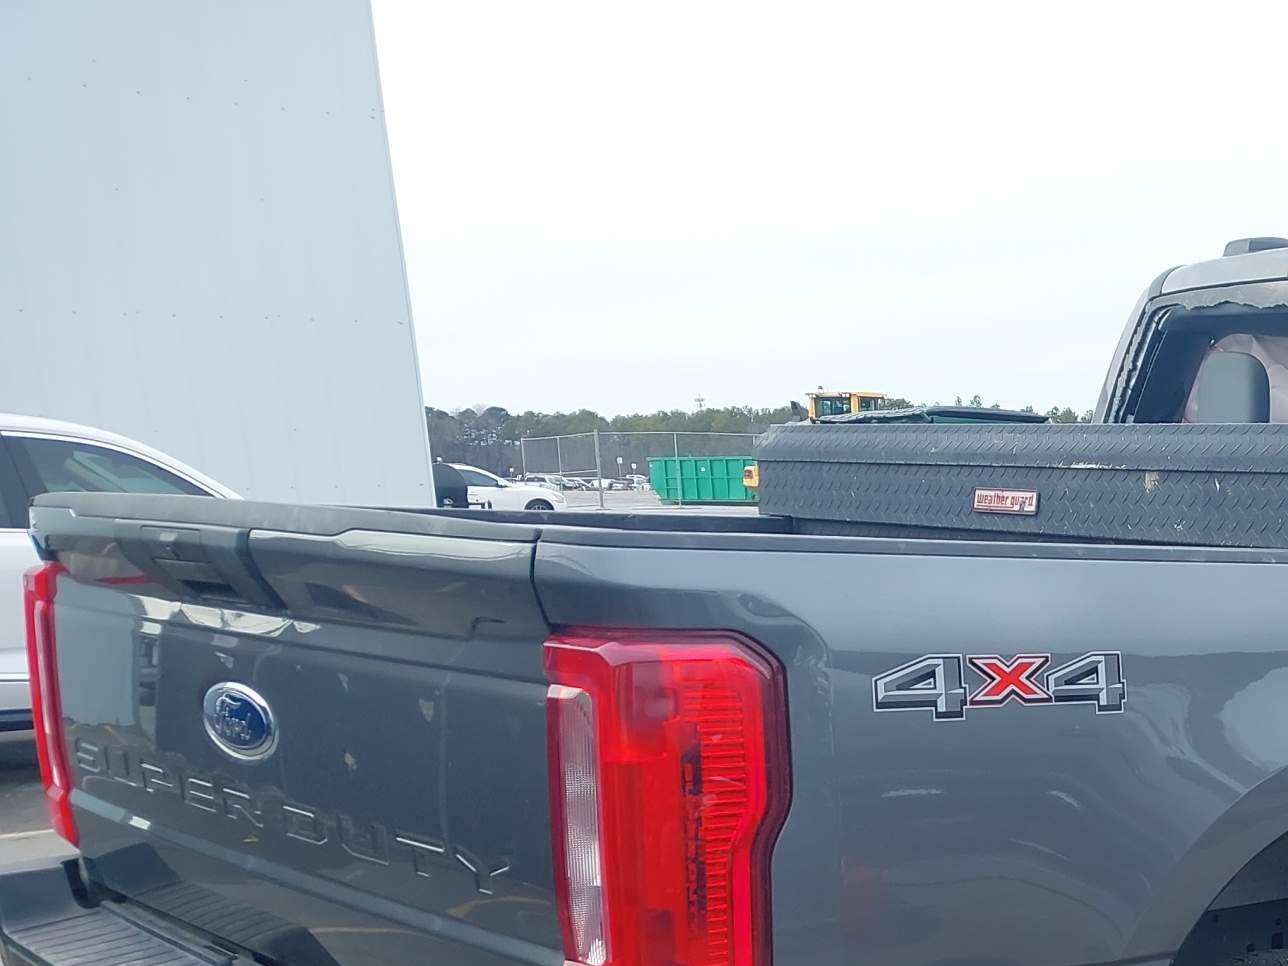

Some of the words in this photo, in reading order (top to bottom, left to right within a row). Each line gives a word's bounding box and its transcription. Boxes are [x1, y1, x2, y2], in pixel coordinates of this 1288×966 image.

[976, 492, 1010, 506] weather
[1011, 494, 1034, 508] guard
[214, 692, 253, 740] Ford
[75, 738, 265, 829] SUPER
[282, 801, 511, 895] DUTY
